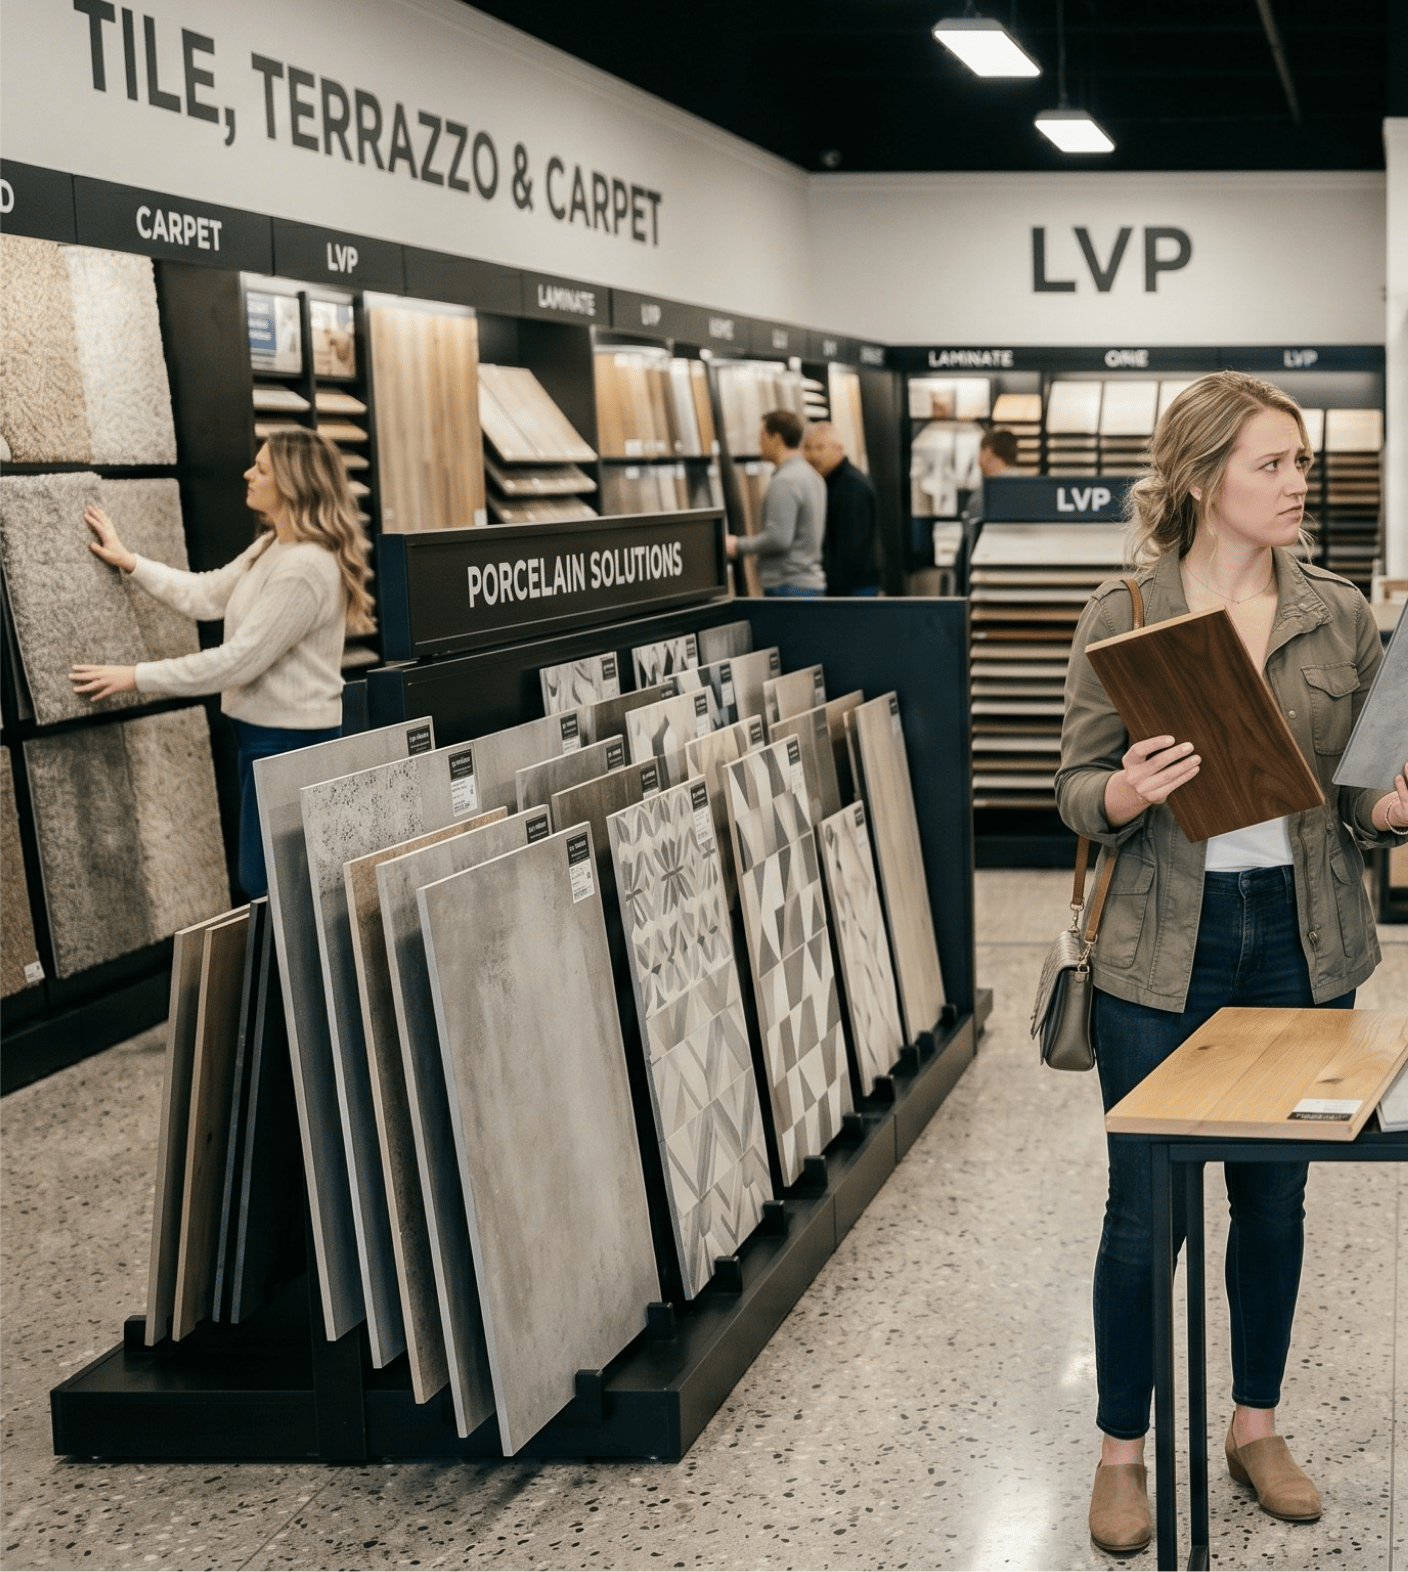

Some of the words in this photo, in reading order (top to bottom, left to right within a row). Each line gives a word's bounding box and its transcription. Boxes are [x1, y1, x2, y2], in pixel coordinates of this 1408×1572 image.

[73, 0, 236, 147] TILE,
[251, 51, 499, 201] TERRAZZO
[511, 141, 534, 212] &
[545, 154, 663, 248] CARPET
[135, 205, 223, 252] CARPET
[326, 241, 359, 274] LVP
[1032, 227, 1193, 293] LVP
[928, 349, 1015, 368] LAMINATE
[1283, 349, 1319, 367] LVP
[1056, 486, 1112, 512] LVP
[467, 553, 586, 608] PORCELAIN
[590, 541, 683, 589] SOLUTIONS
